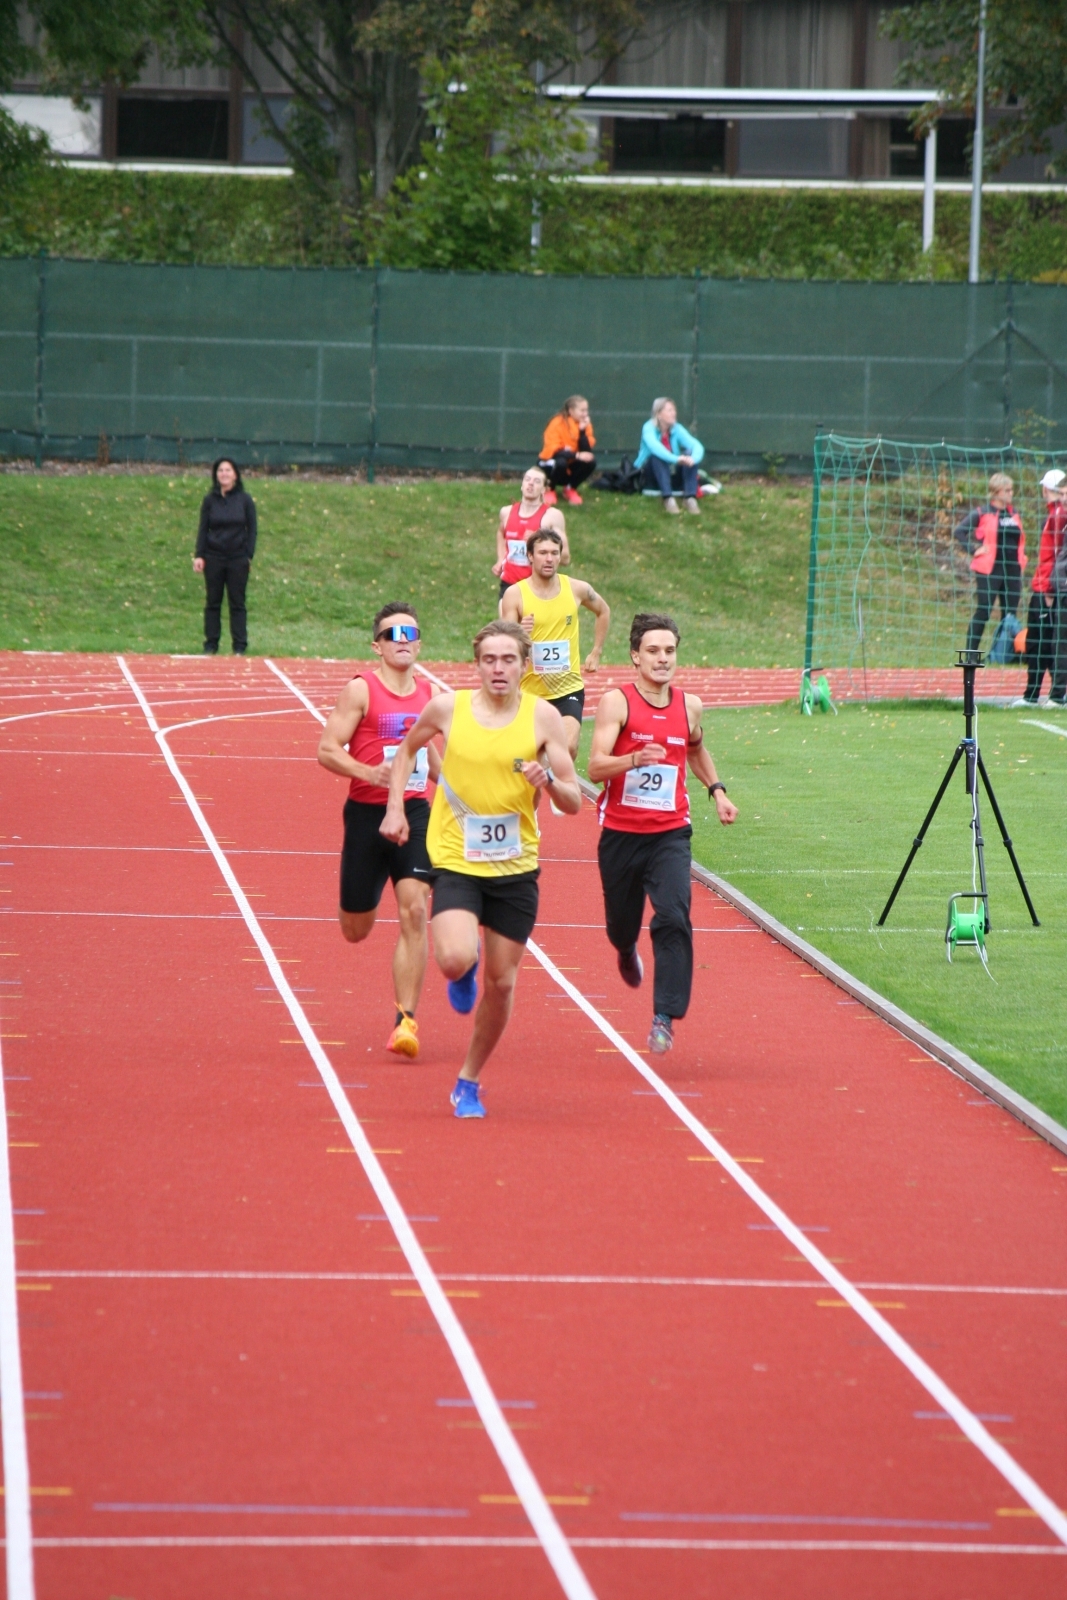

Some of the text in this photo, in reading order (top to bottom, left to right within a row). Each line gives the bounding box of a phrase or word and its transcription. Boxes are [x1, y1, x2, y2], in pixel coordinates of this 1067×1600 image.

[512, 545, 525, 556] 24
[542, 647, 560, 661] 25
[638, 772, 663, 792] 29
[480, 823, 507, 844] 30
